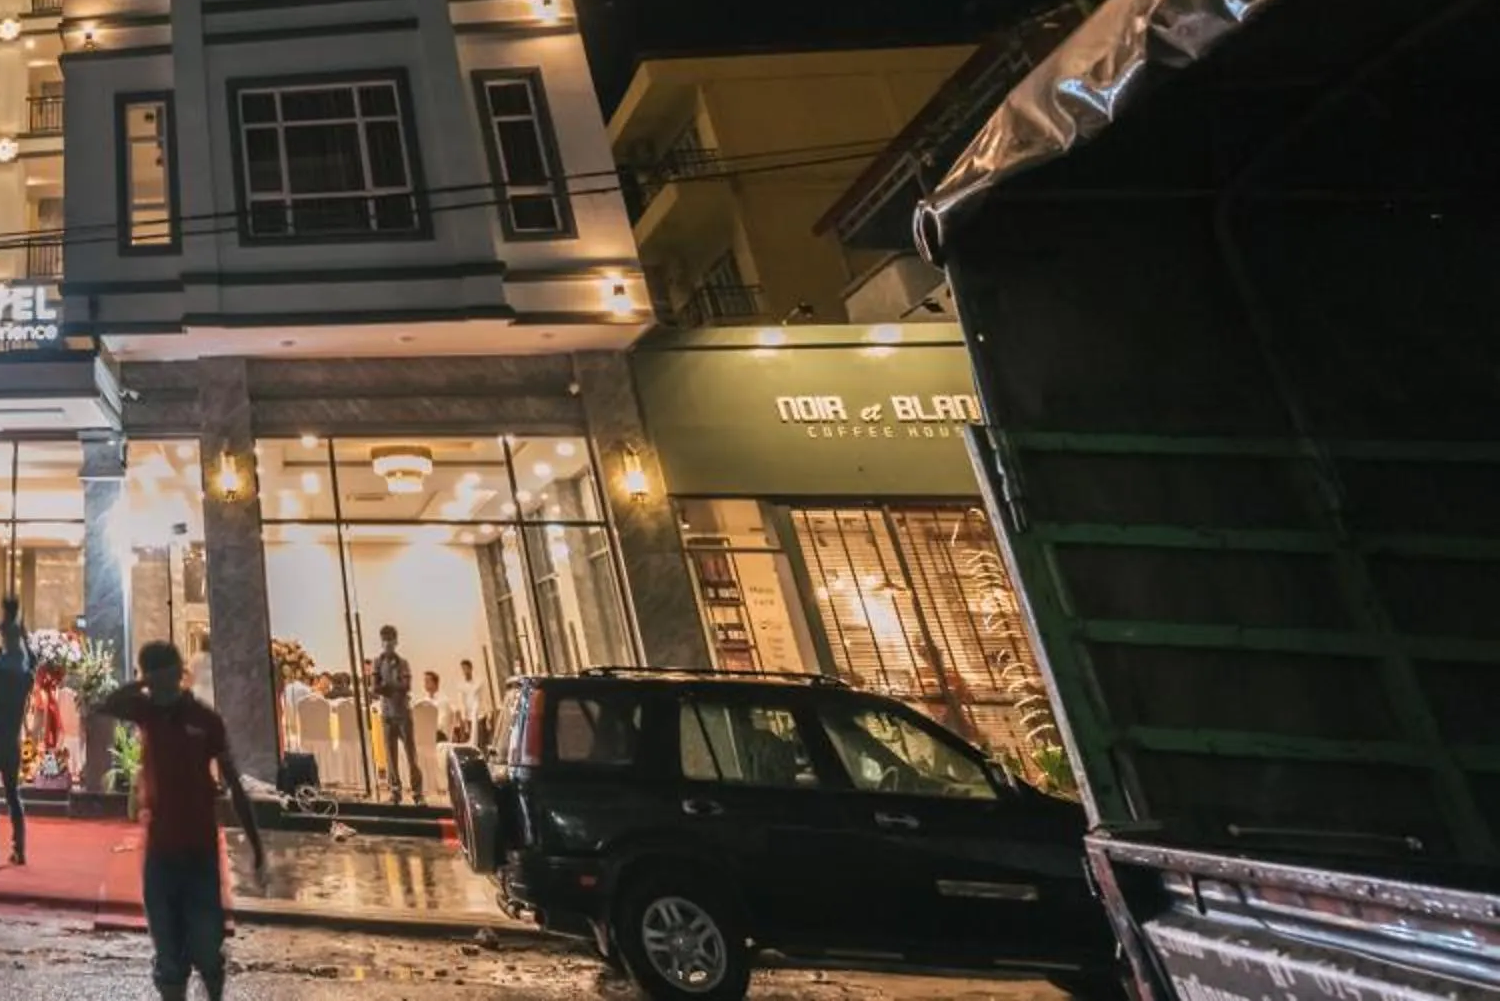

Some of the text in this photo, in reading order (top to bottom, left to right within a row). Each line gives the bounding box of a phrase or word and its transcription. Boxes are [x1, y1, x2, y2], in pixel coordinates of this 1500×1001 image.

[776, 395, 848, 423] NOIR
[806, 425, 965, 439] COFFEE HOUS
